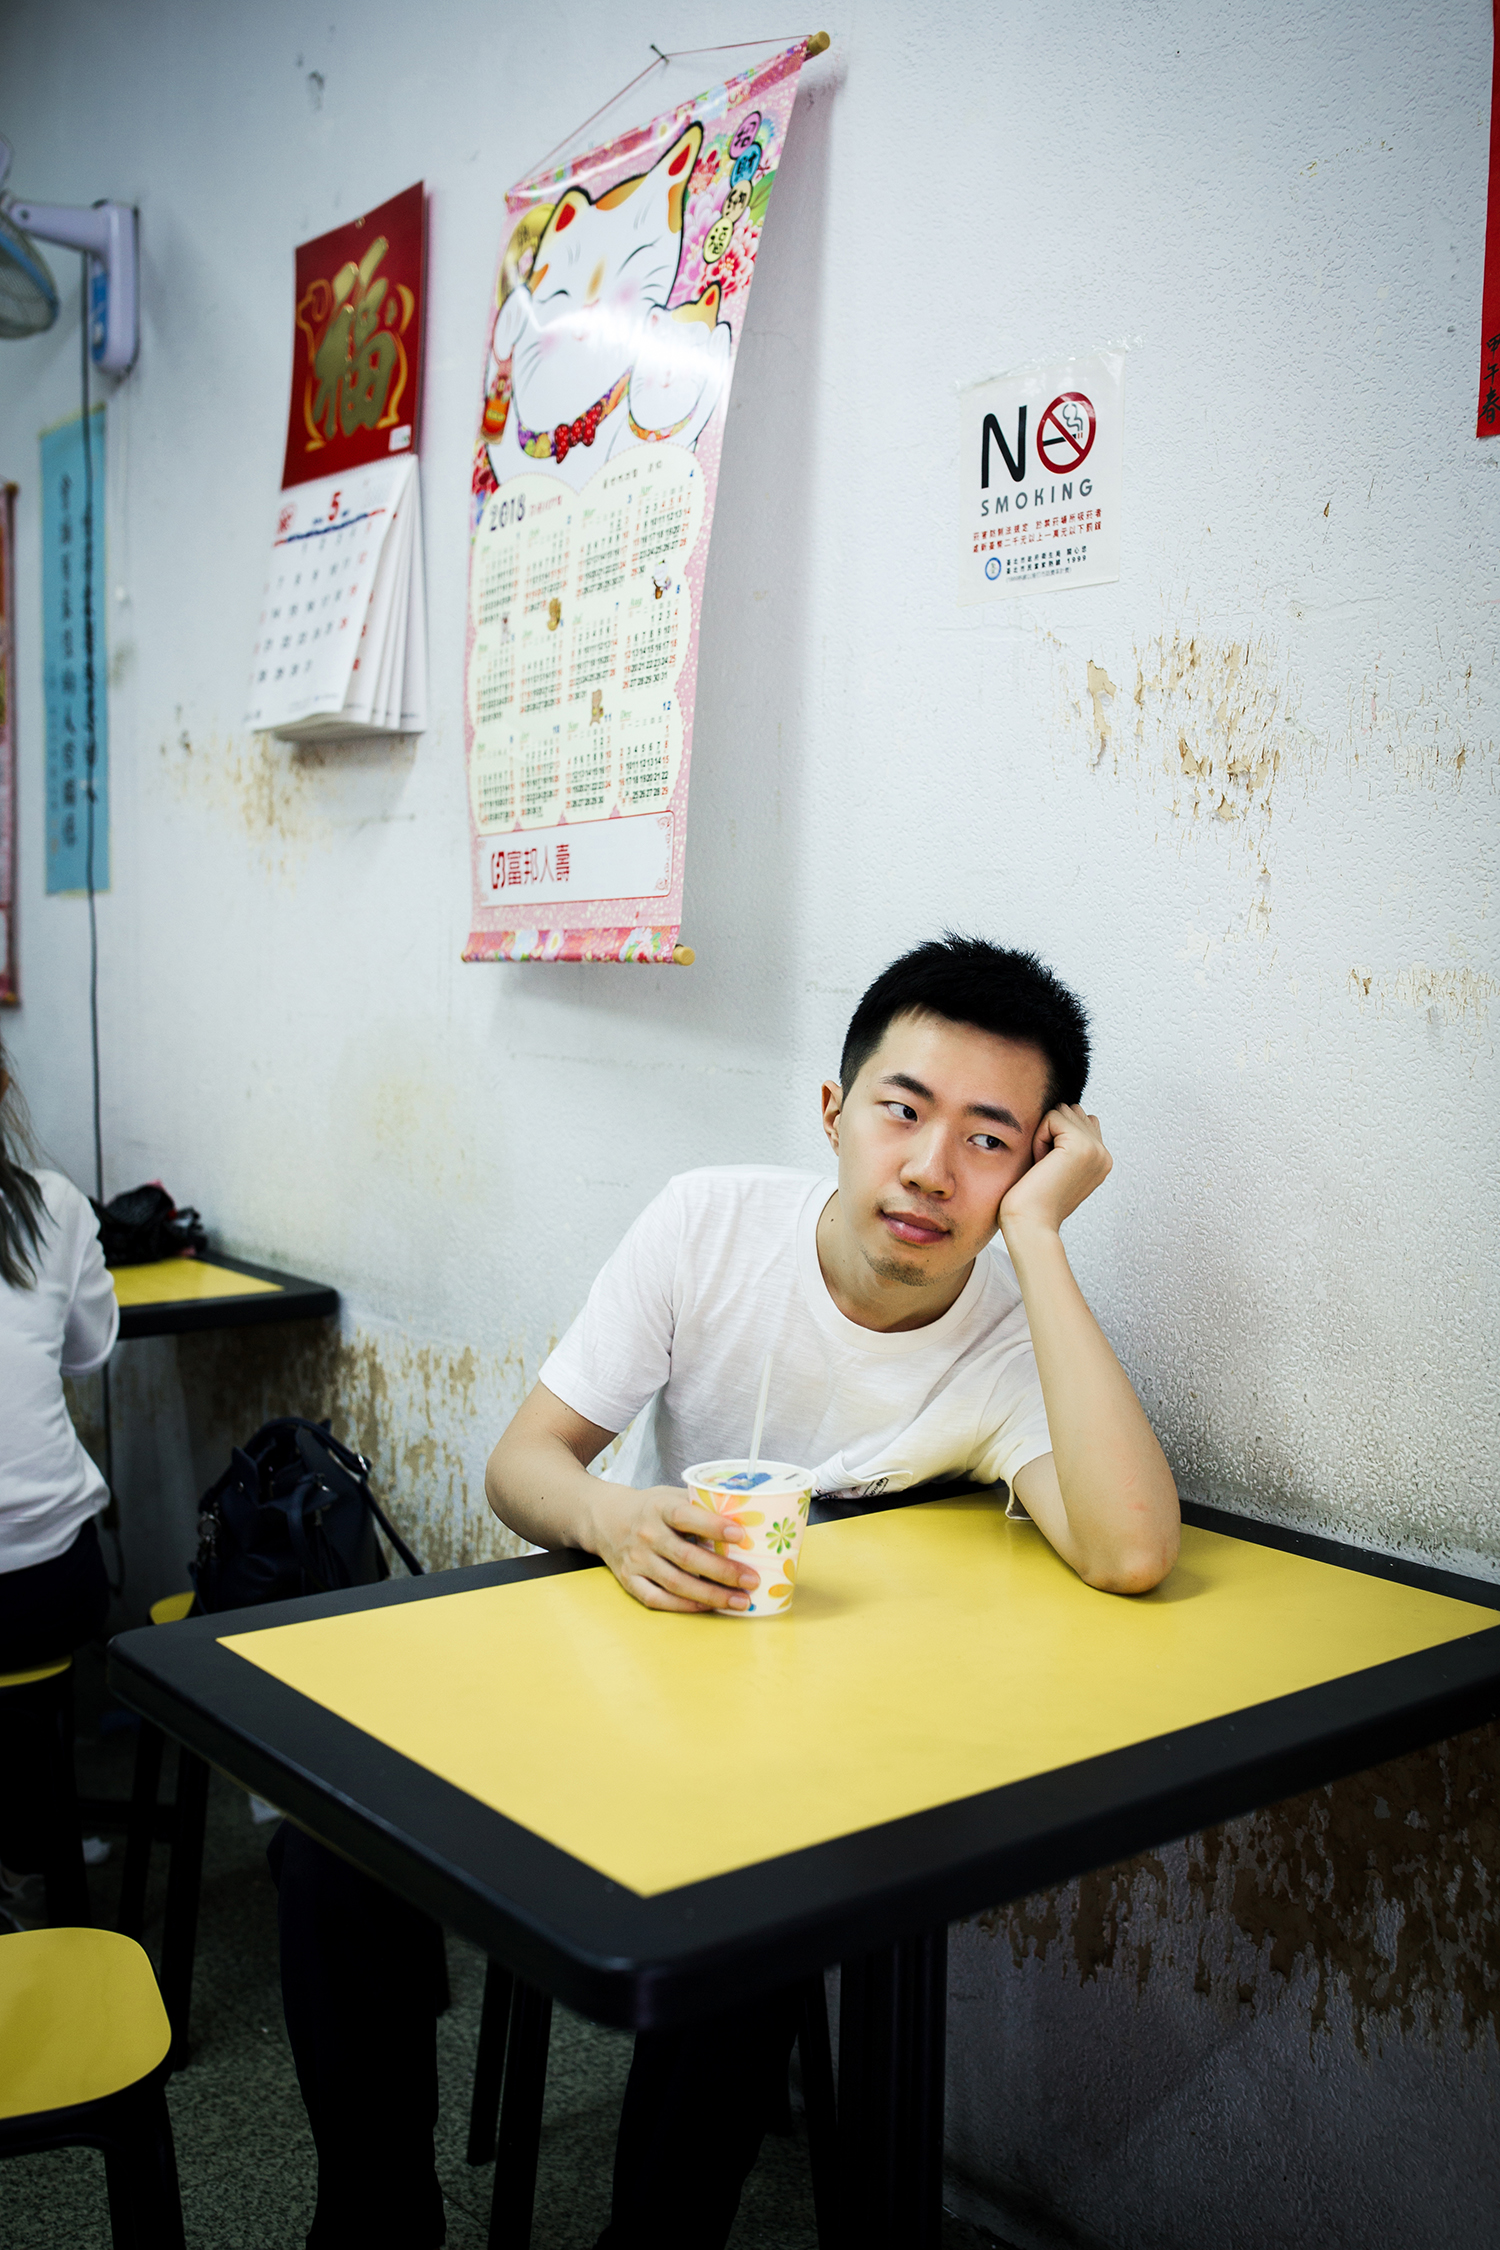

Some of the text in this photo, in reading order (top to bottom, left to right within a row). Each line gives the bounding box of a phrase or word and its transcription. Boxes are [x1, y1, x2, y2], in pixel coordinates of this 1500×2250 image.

[313, 236, 398, 438] 福
[327, 491, 341, 522] 5
[490, 494, 526, 532] 2018
[981, 478, 1092, 517] SMOKING
[1066, 554, 1087, 564] 1999
[604, 713, 612, 722] 11
[663, 700, 671, 711] 12
[508, 844, 570, 886] 富邦人壽
